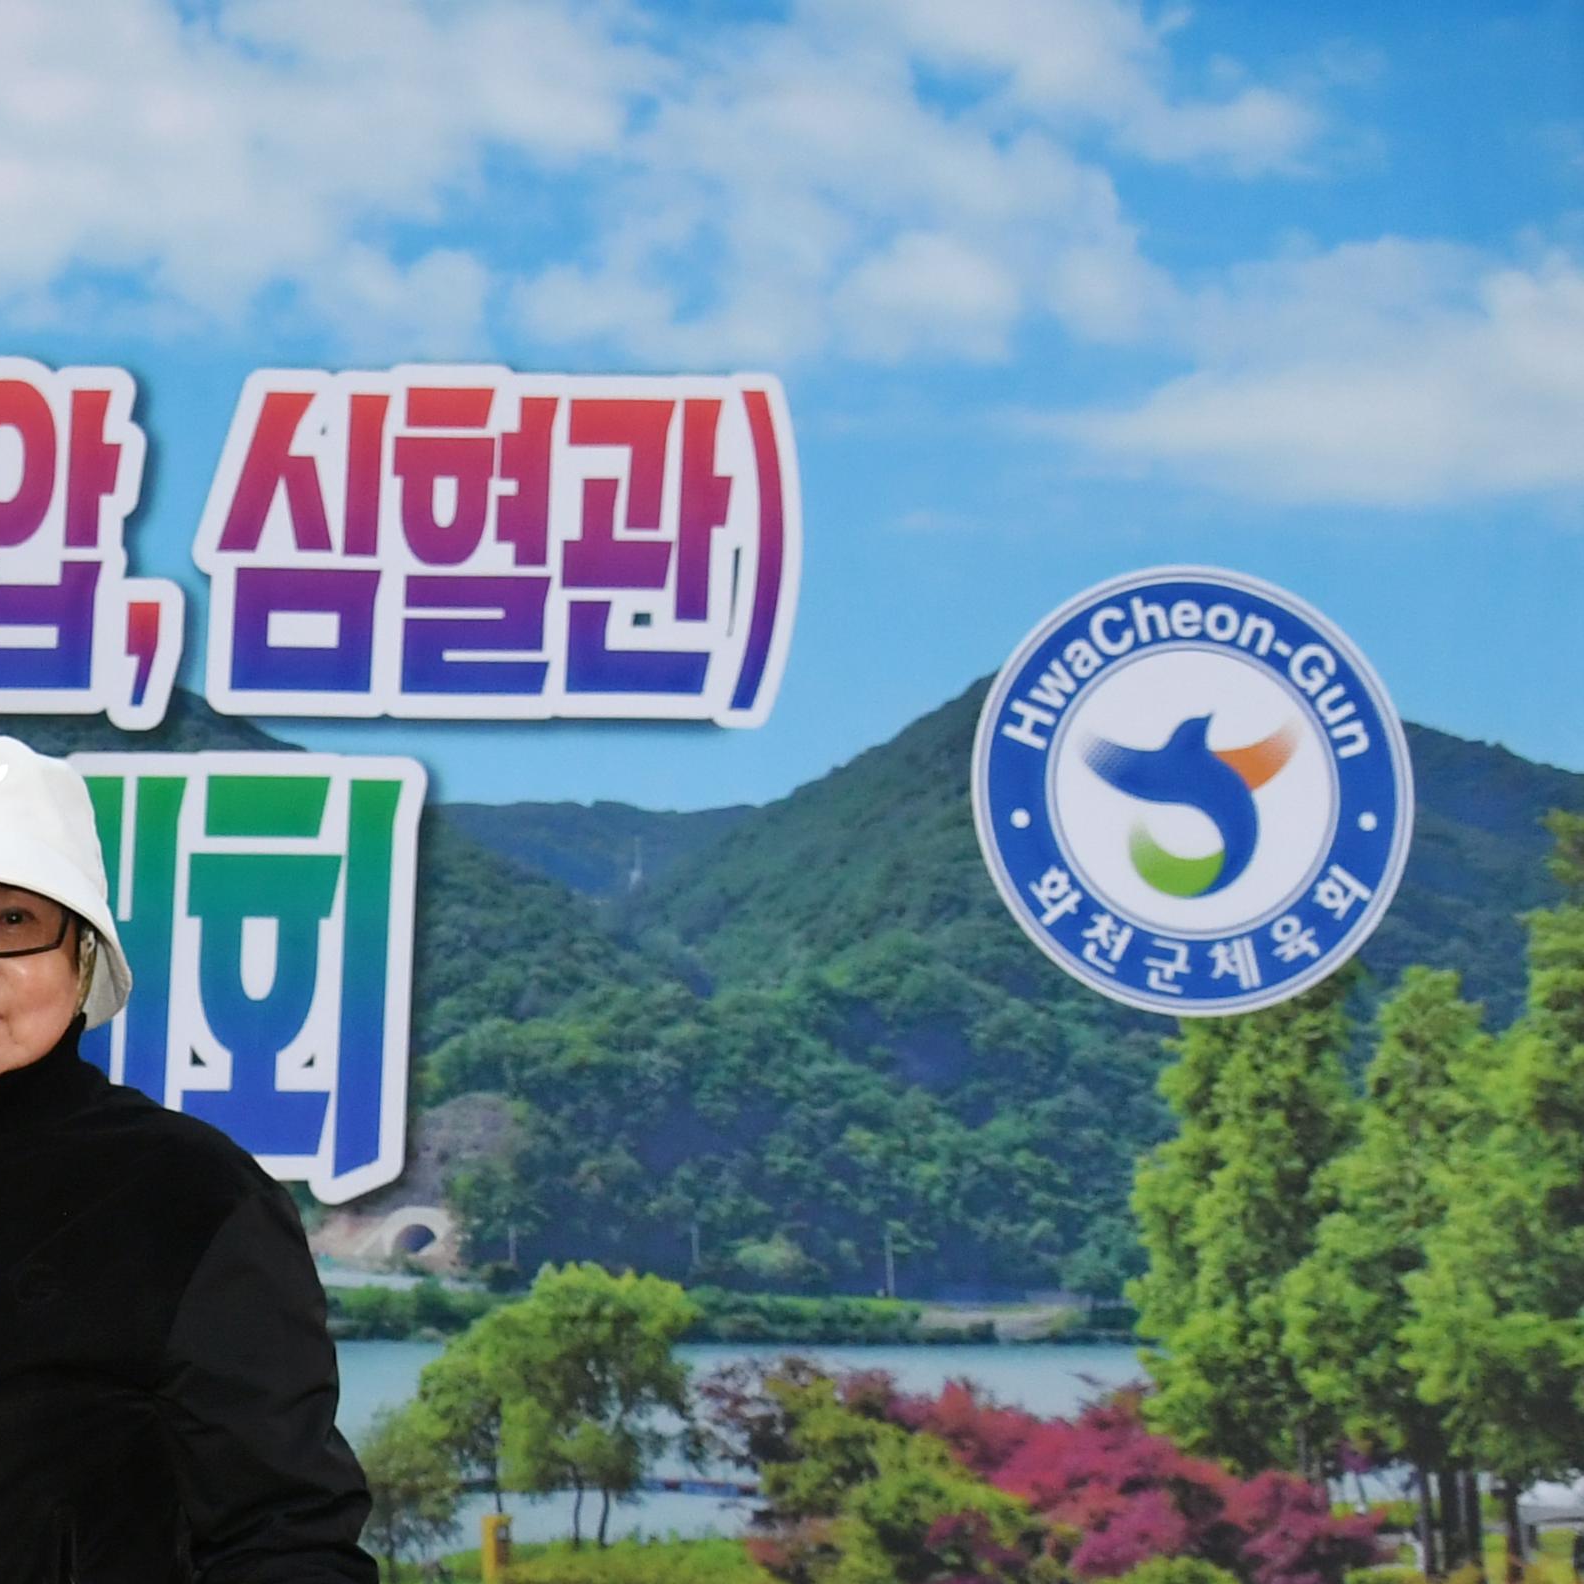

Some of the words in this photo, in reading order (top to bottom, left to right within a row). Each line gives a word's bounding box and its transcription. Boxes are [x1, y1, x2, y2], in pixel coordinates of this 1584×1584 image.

[218, 387, 784, 712] 심혈관)
[1001, 596, 1371, 760] HwaCheon-Gun
[1028, 864, 1372, 995] 화천군체육회
